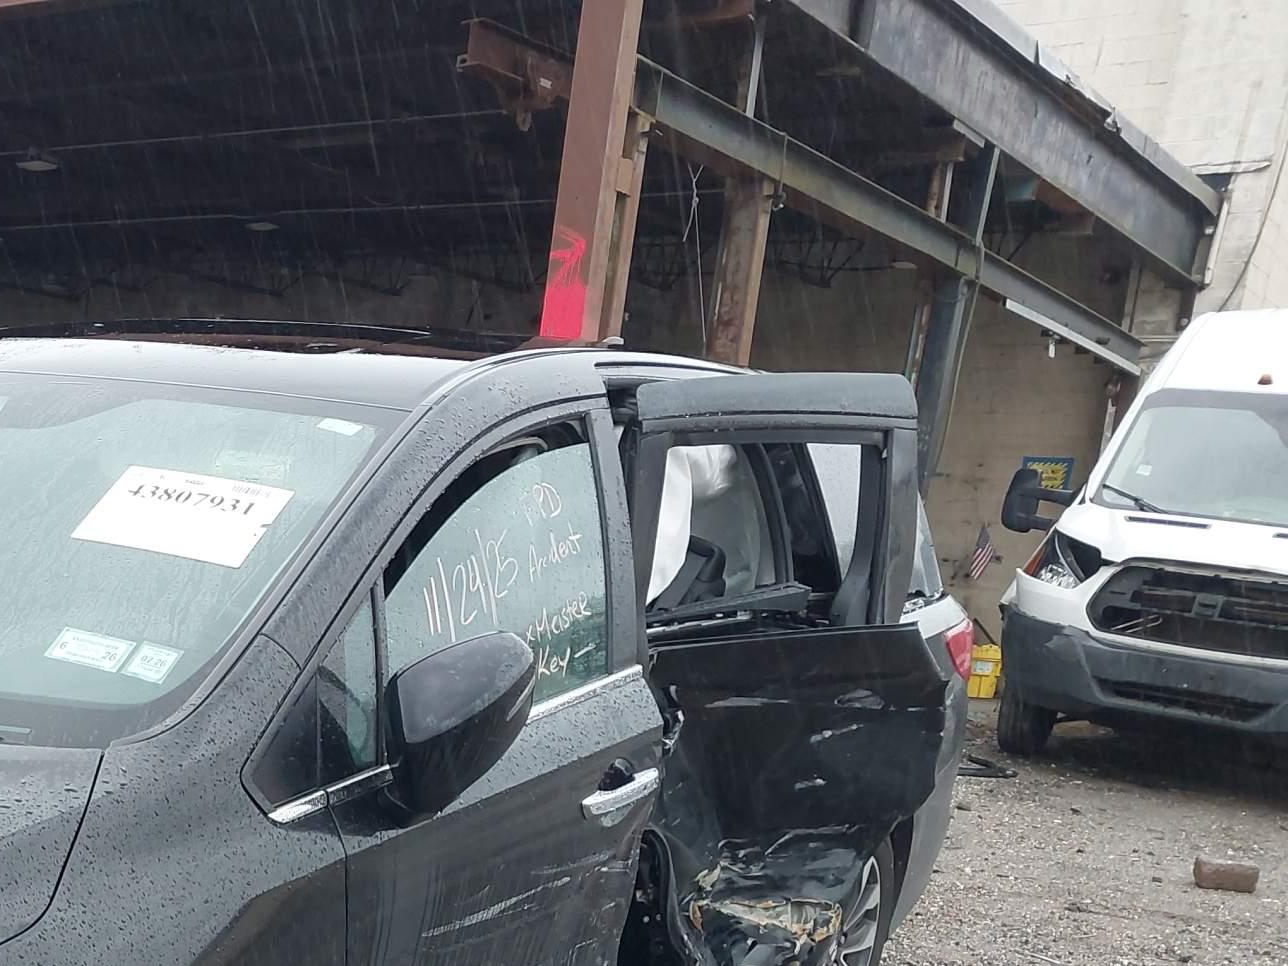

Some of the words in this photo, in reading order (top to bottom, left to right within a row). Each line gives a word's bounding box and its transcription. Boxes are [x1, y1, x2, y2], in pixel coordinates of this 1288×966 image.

[128, 484, 256, 515] 43807931
[423, 528, 519, 642] 11/24/25
[537, 645, 572, 680] Key
